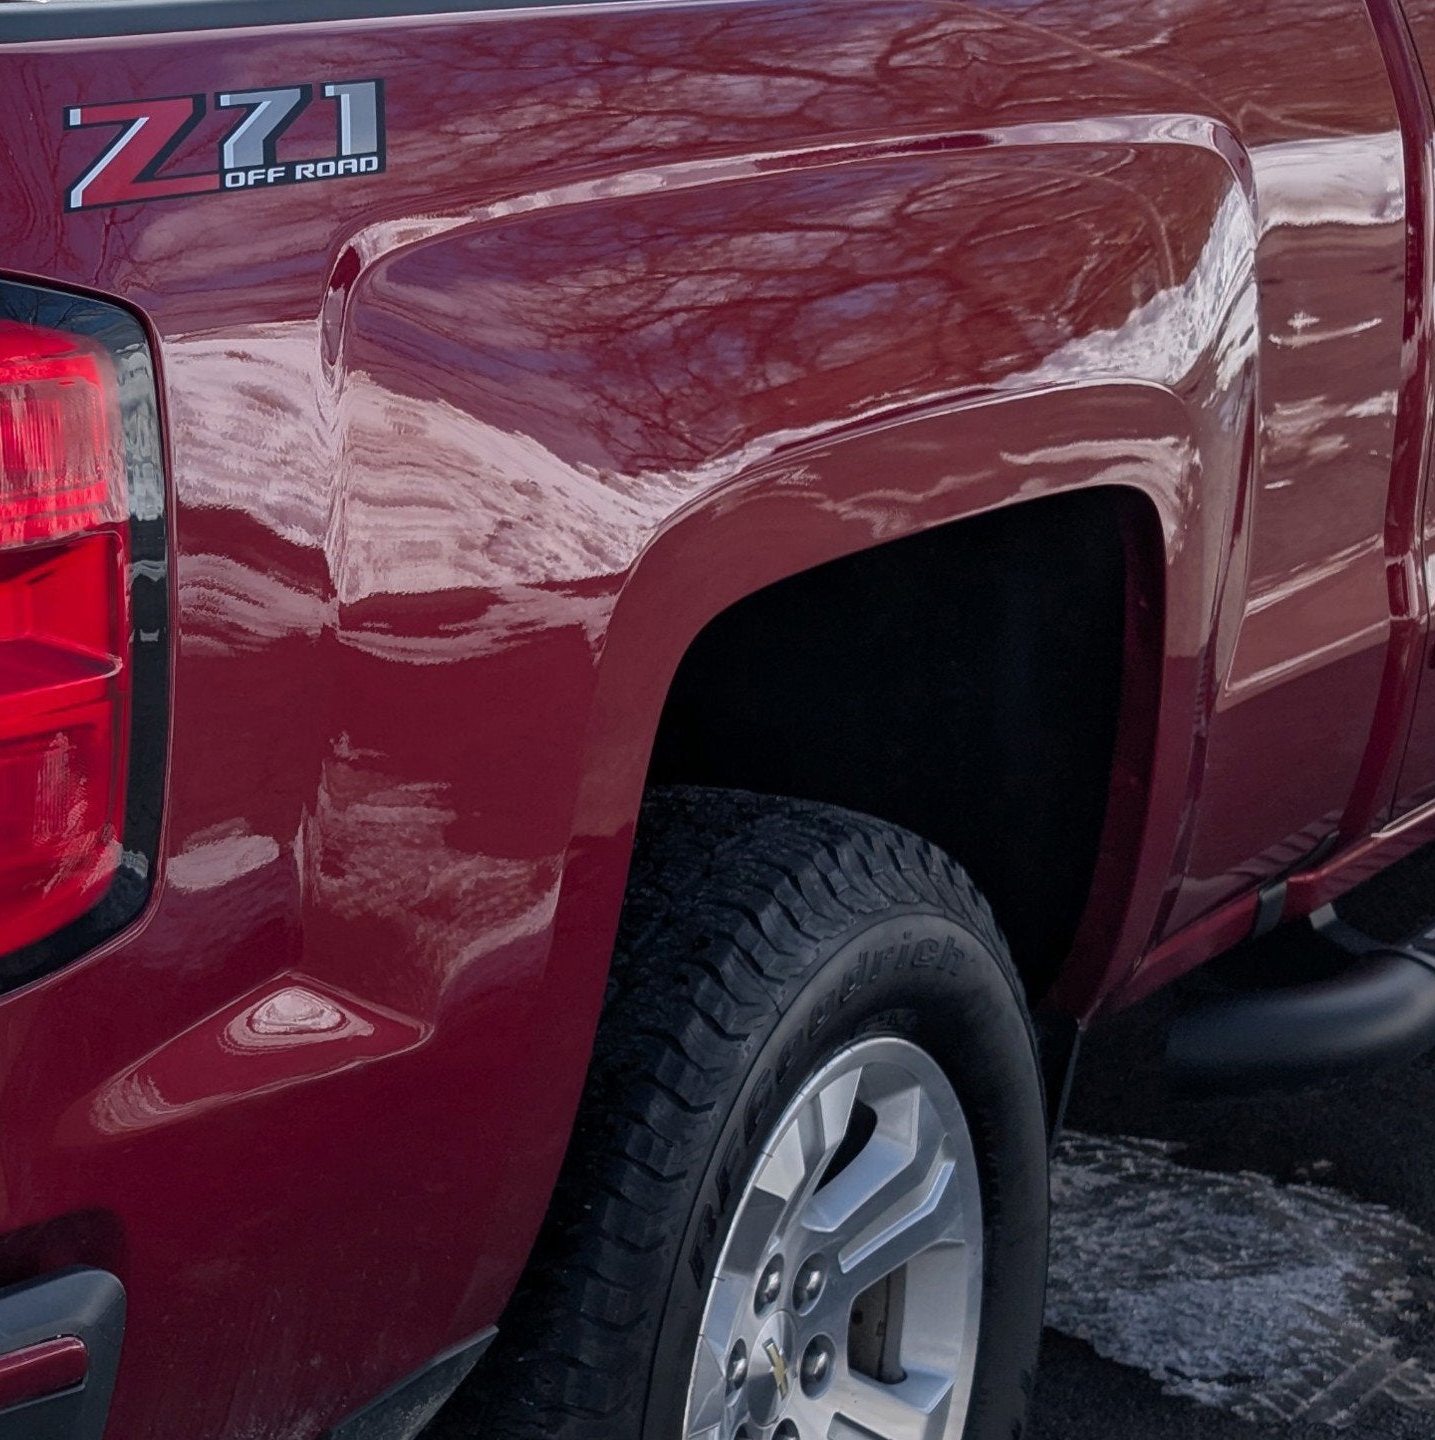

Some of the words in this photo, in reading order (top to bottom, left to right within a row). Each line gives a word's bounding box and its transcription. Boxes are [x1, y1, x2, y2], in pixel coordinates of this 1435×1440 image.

[63, 78, 385, 212] Z71
[224, 166, 285, 188] OFF
[294, 156, 379, 180] ROAD
